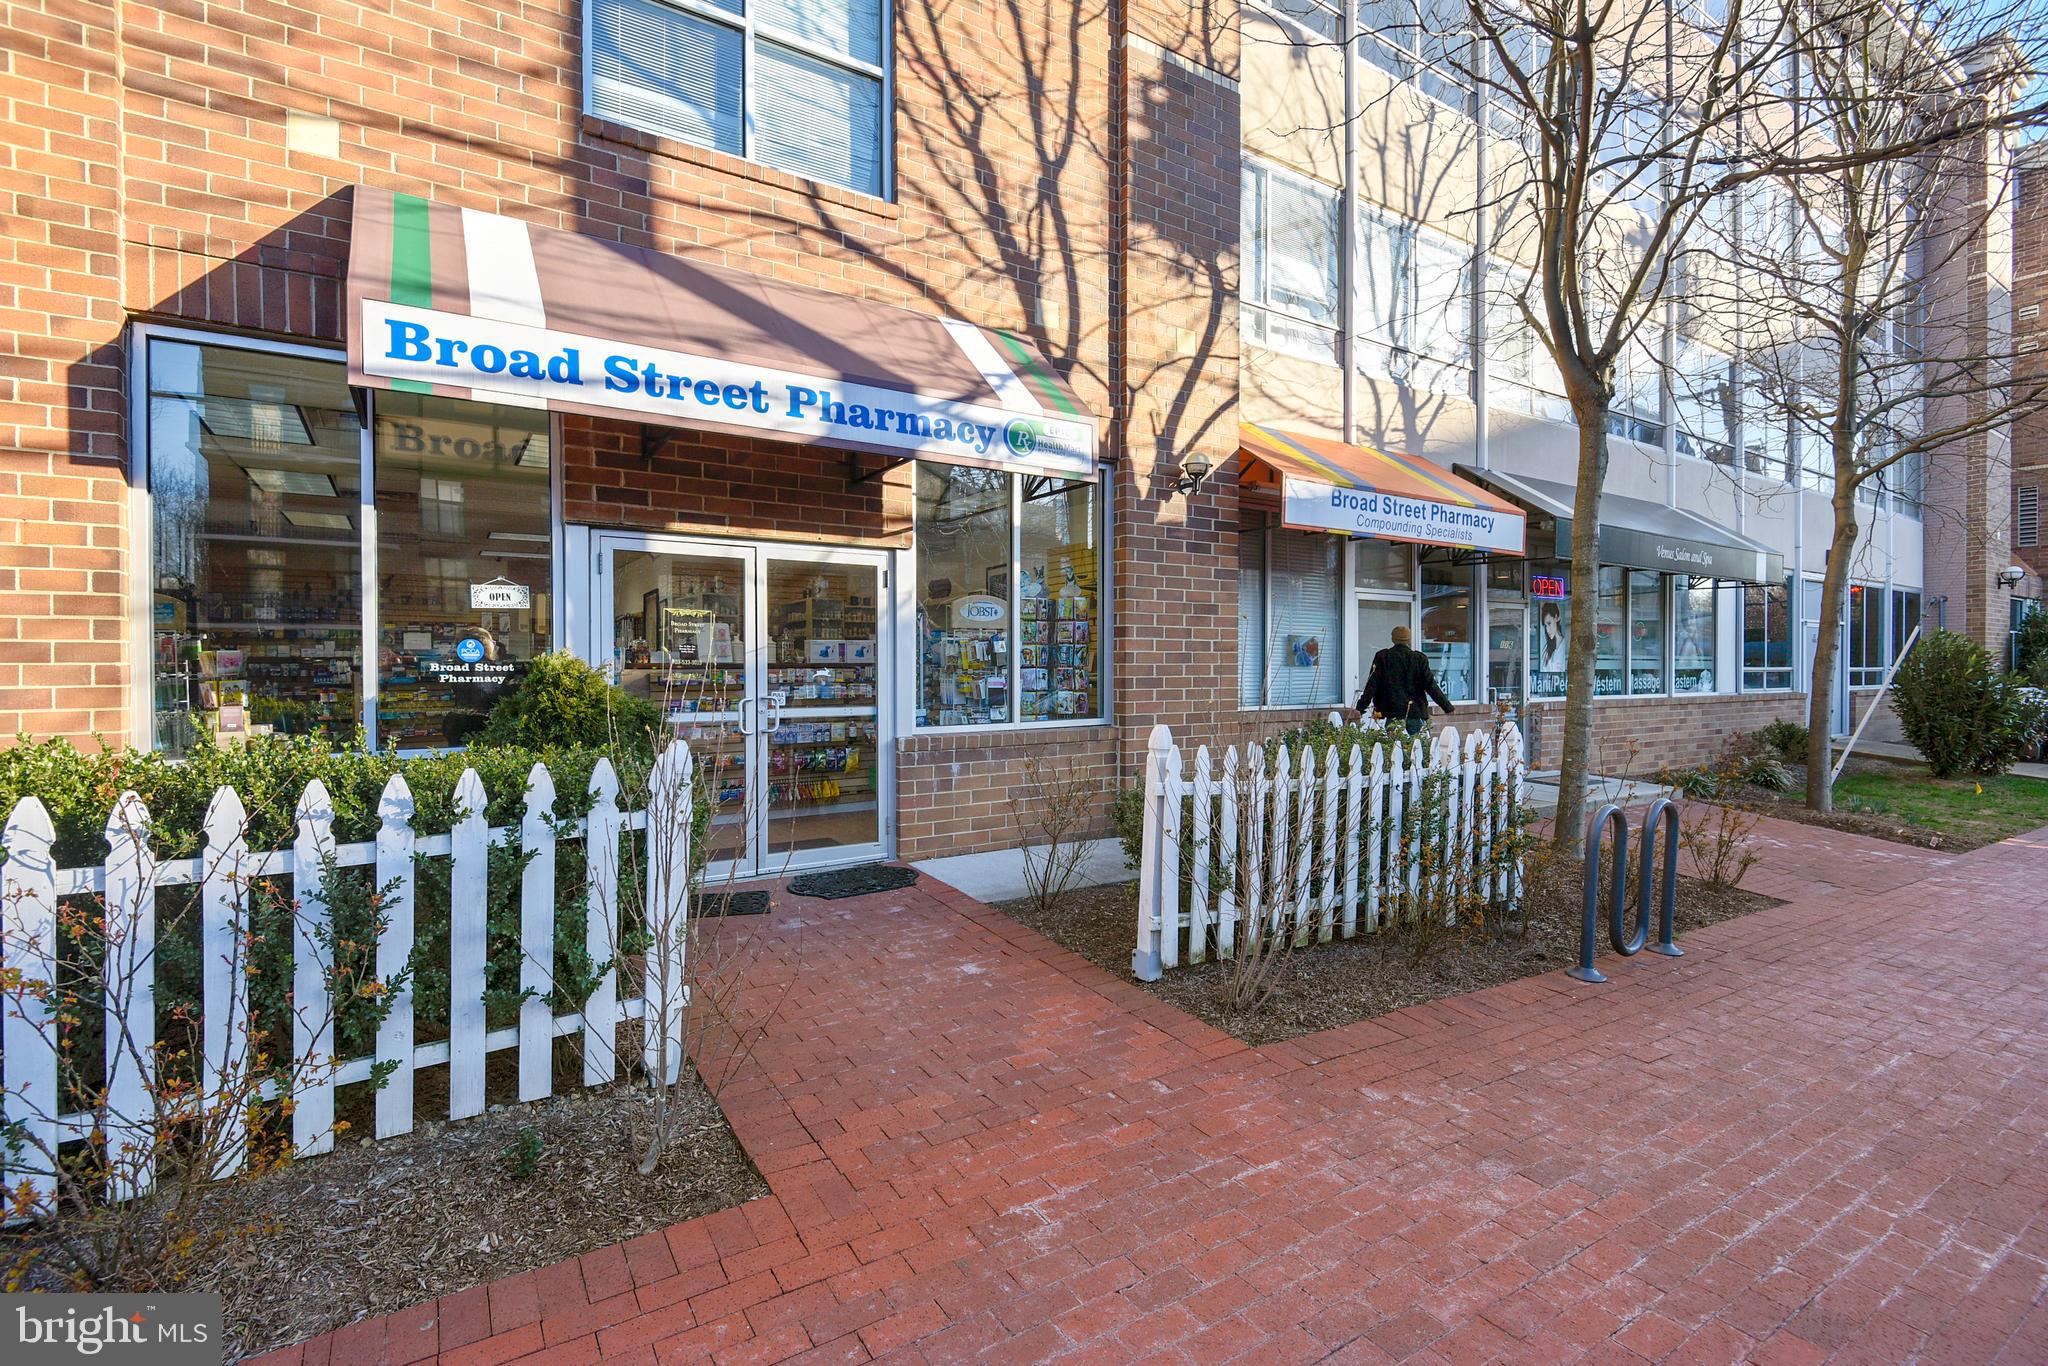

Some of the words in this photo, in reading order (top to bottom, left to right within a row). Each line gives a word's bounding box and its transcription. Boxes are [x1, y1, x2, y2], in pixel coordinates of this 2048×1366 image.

[385, 318, 583, 386] Broad
[604, 355, 769, 414] Street
[786, 384, 996, 453] Pharmacy
[1331, 489, 1378, 513] Broad
[1383, 496, 1427, 521] Street
[1431, 504, 1495, 533] Pharmacy
[1356, 514, 1422, 537] Compounding
[1425, 523, 1473, 541] Specialists
[1674, 547, 1690, 561] Salon
[1691, 551, 1703, 563] and
[1702, 551, 1713, 568] Spa
[1533, 579, 1562, 596] OPEN
[489, 592, 512, 602] OPEN
[967, 604, 995, 617] JOBST
[429, 662, 470, 672] Broad
[475, 662, 515, 672] Street
[439, 674, 506, 684] Pharmacy
